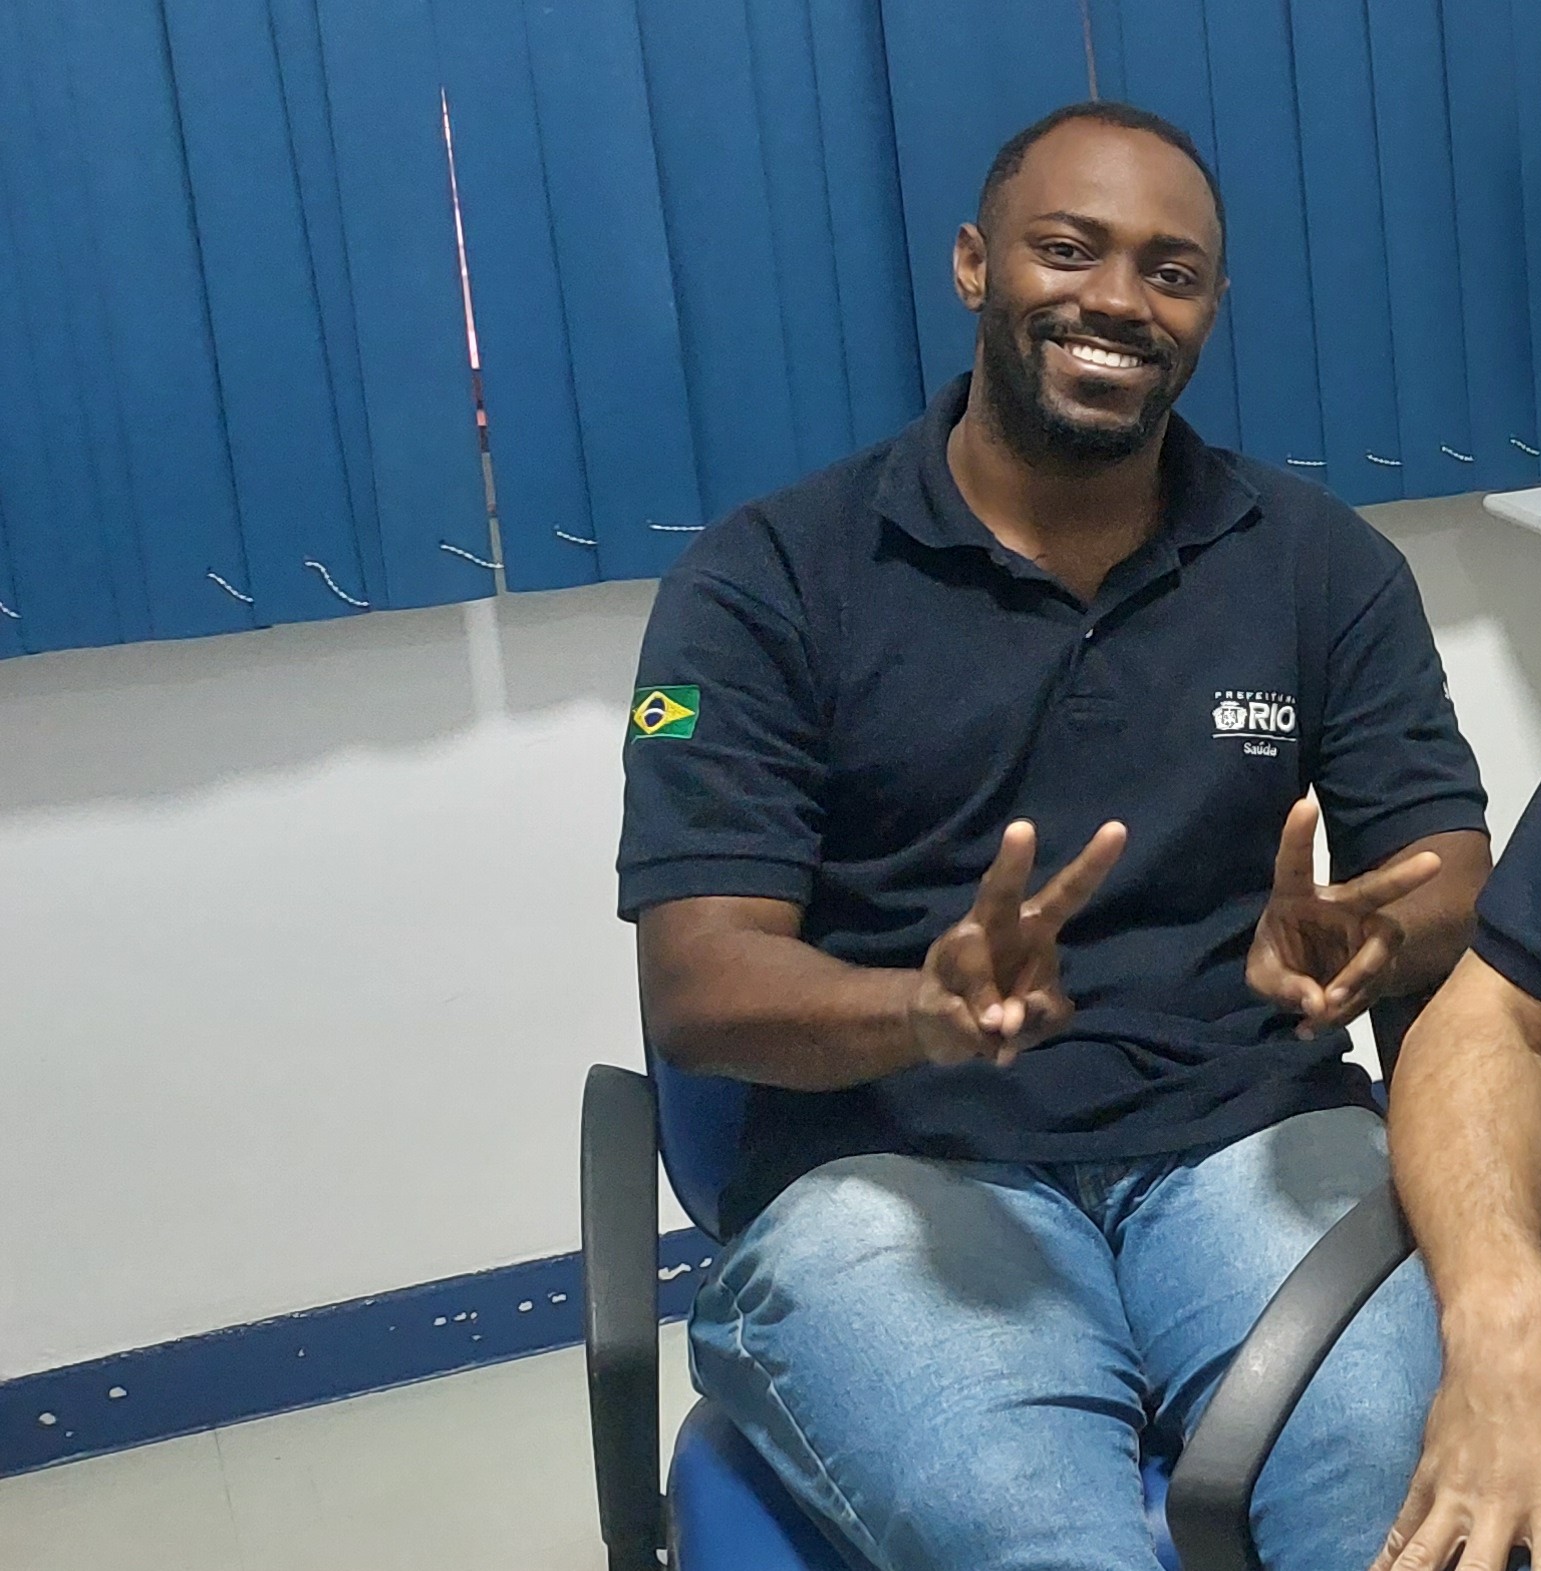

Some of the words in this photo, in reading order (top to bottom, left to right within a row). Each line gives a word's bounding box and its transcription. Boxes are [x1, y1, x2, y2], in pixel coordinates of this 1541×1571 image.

[1214, 690, 1296, 704] PREFEITURA
[1248, 701, 1296, 733] RIO
[1243, 740, 1277, 757] Saúde
